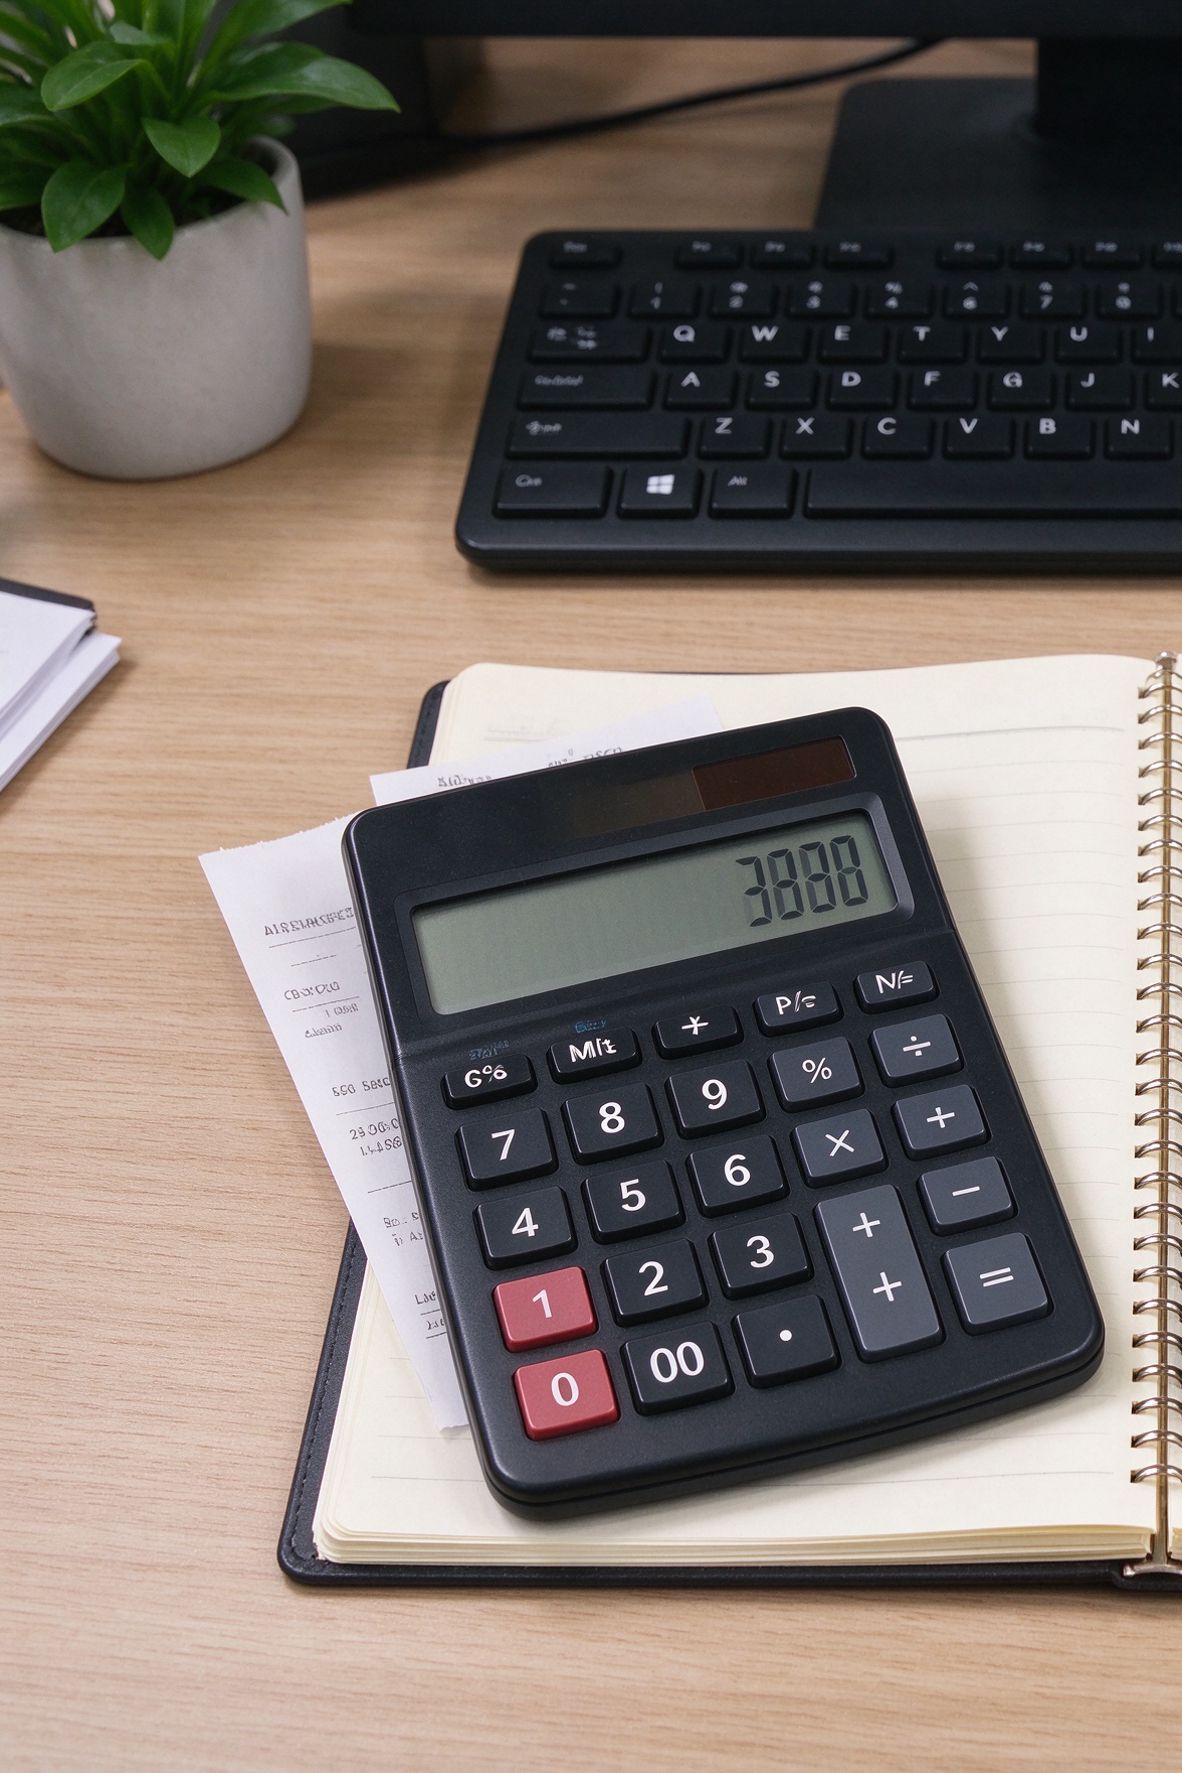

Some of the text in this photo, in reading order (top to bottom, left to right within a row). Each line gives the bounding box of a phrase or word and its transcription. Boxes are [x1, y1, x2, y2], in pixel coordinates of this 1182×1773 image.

[673, 325, 695, 342] Q
[752, 326, 778, 341] W
[834, 325, 848, 341] E
[914, 326, 930, 341] T
[991, 327, 1007, 341] Y
[1070, 327, 1088, 342] U
[681, 371, 700, 387] A
[764, 370, 780, 388] S
[841, 371, 861, 387] D
[924, 371, 939, 386] F
[1002, 372, 1023, 388] G
[1080, 372, 1095, 388] J
[1162, 373, 1178, 388] K
[715, 417, 733, 434] Z
[796, 418, 814, 434] X
[877, 417, 897, 435] C
[959, 418, 978, 434] V
[1039, 418, 1057, 434] B
[1121, 419, 1140, 434] N
[491, 1035, 931, 1161] 7 8 9 % ÷
[511, 1207, 539, 1237] 4
[620, 1178, 646, 1212] 5
[724, 1154, 751, 1187] 6
[926, 1106, 955, 1129] +
[532, 1289, 553, 1319] 1
[638, 1260, 669, 1297] 2
[746, 1235, 775, 1268] 3
[852, 1212, 881, 1238] +
[872, 1266, 1014, 1302] + =
[551, 1372, 579, 1407] 0
[649, 1341, 705, 1383] 00
